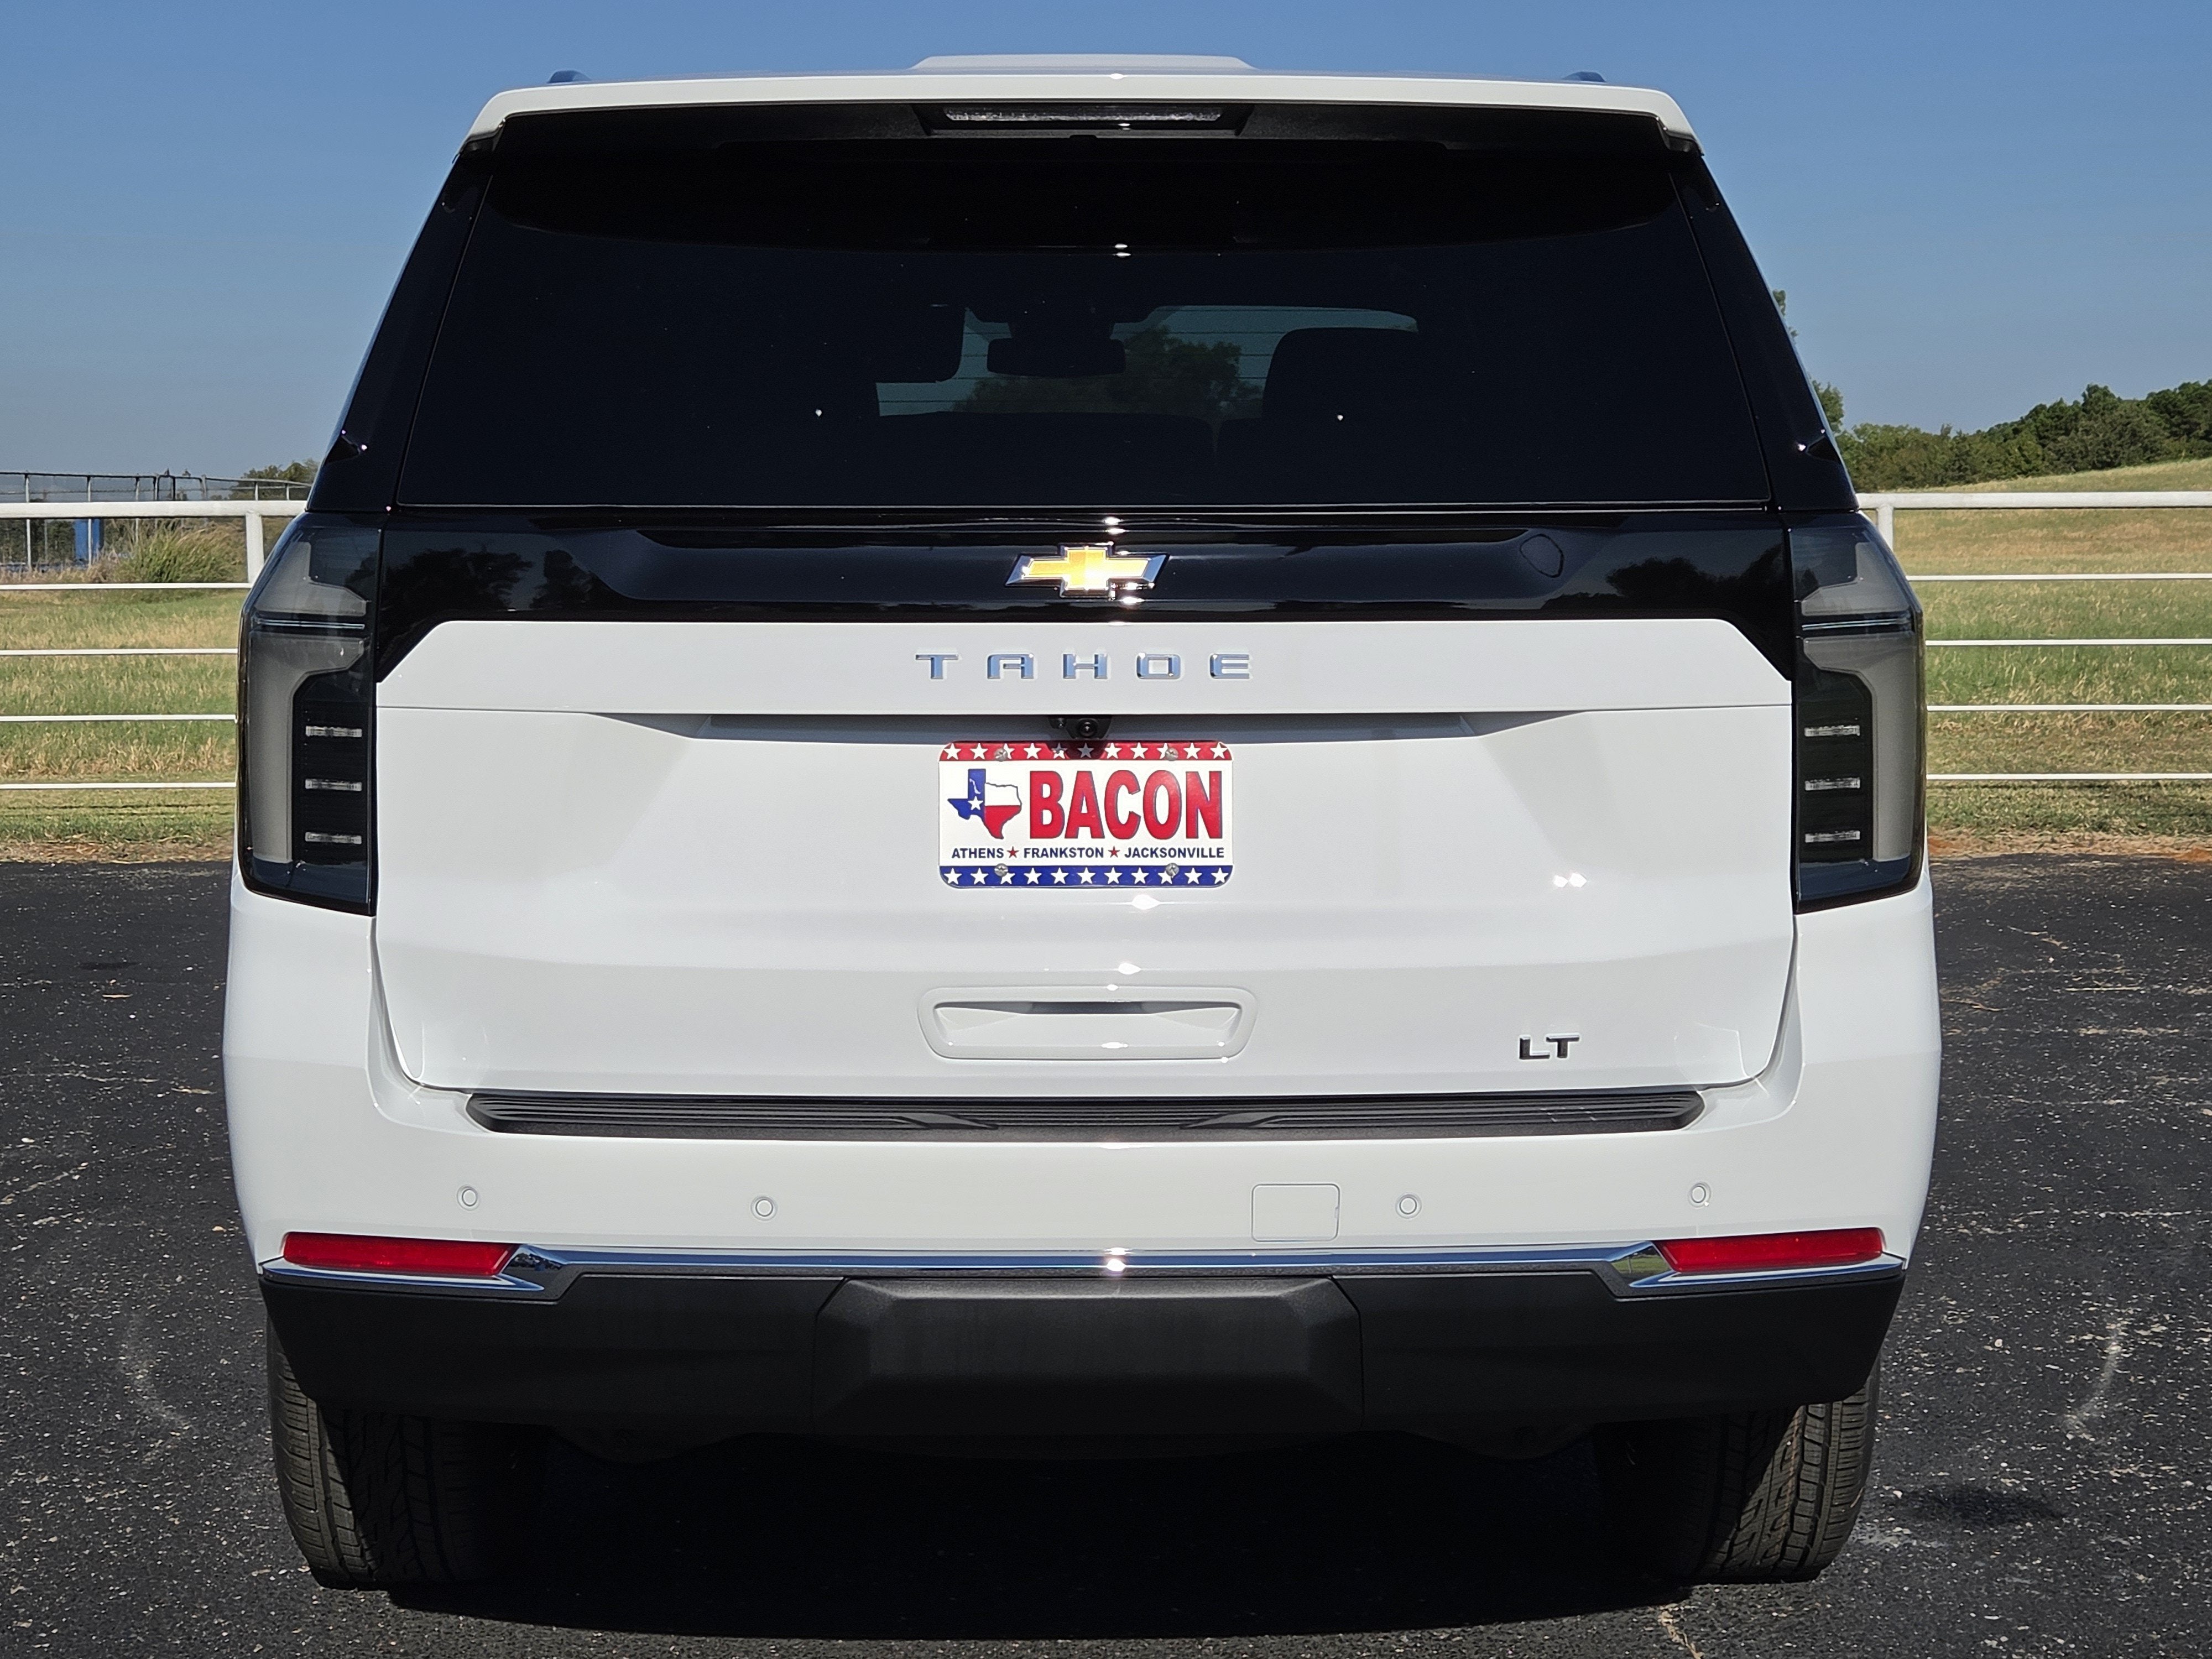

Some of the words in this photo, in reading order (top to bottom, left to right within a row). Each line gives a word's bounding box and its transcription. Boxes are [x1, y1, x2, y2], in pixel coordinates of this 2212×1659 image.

[915, 653, 1251, 680] TAHOE
[1029, 770, 1223, 839] BACON
[951, 847, 1004, 858] ATHENS
[1023, 847, 1104, 858] FRANKSTON
[1124, 847, 1224, 858] JACKSONVILLE
[1519, 1034, 1580, 1060] LT
